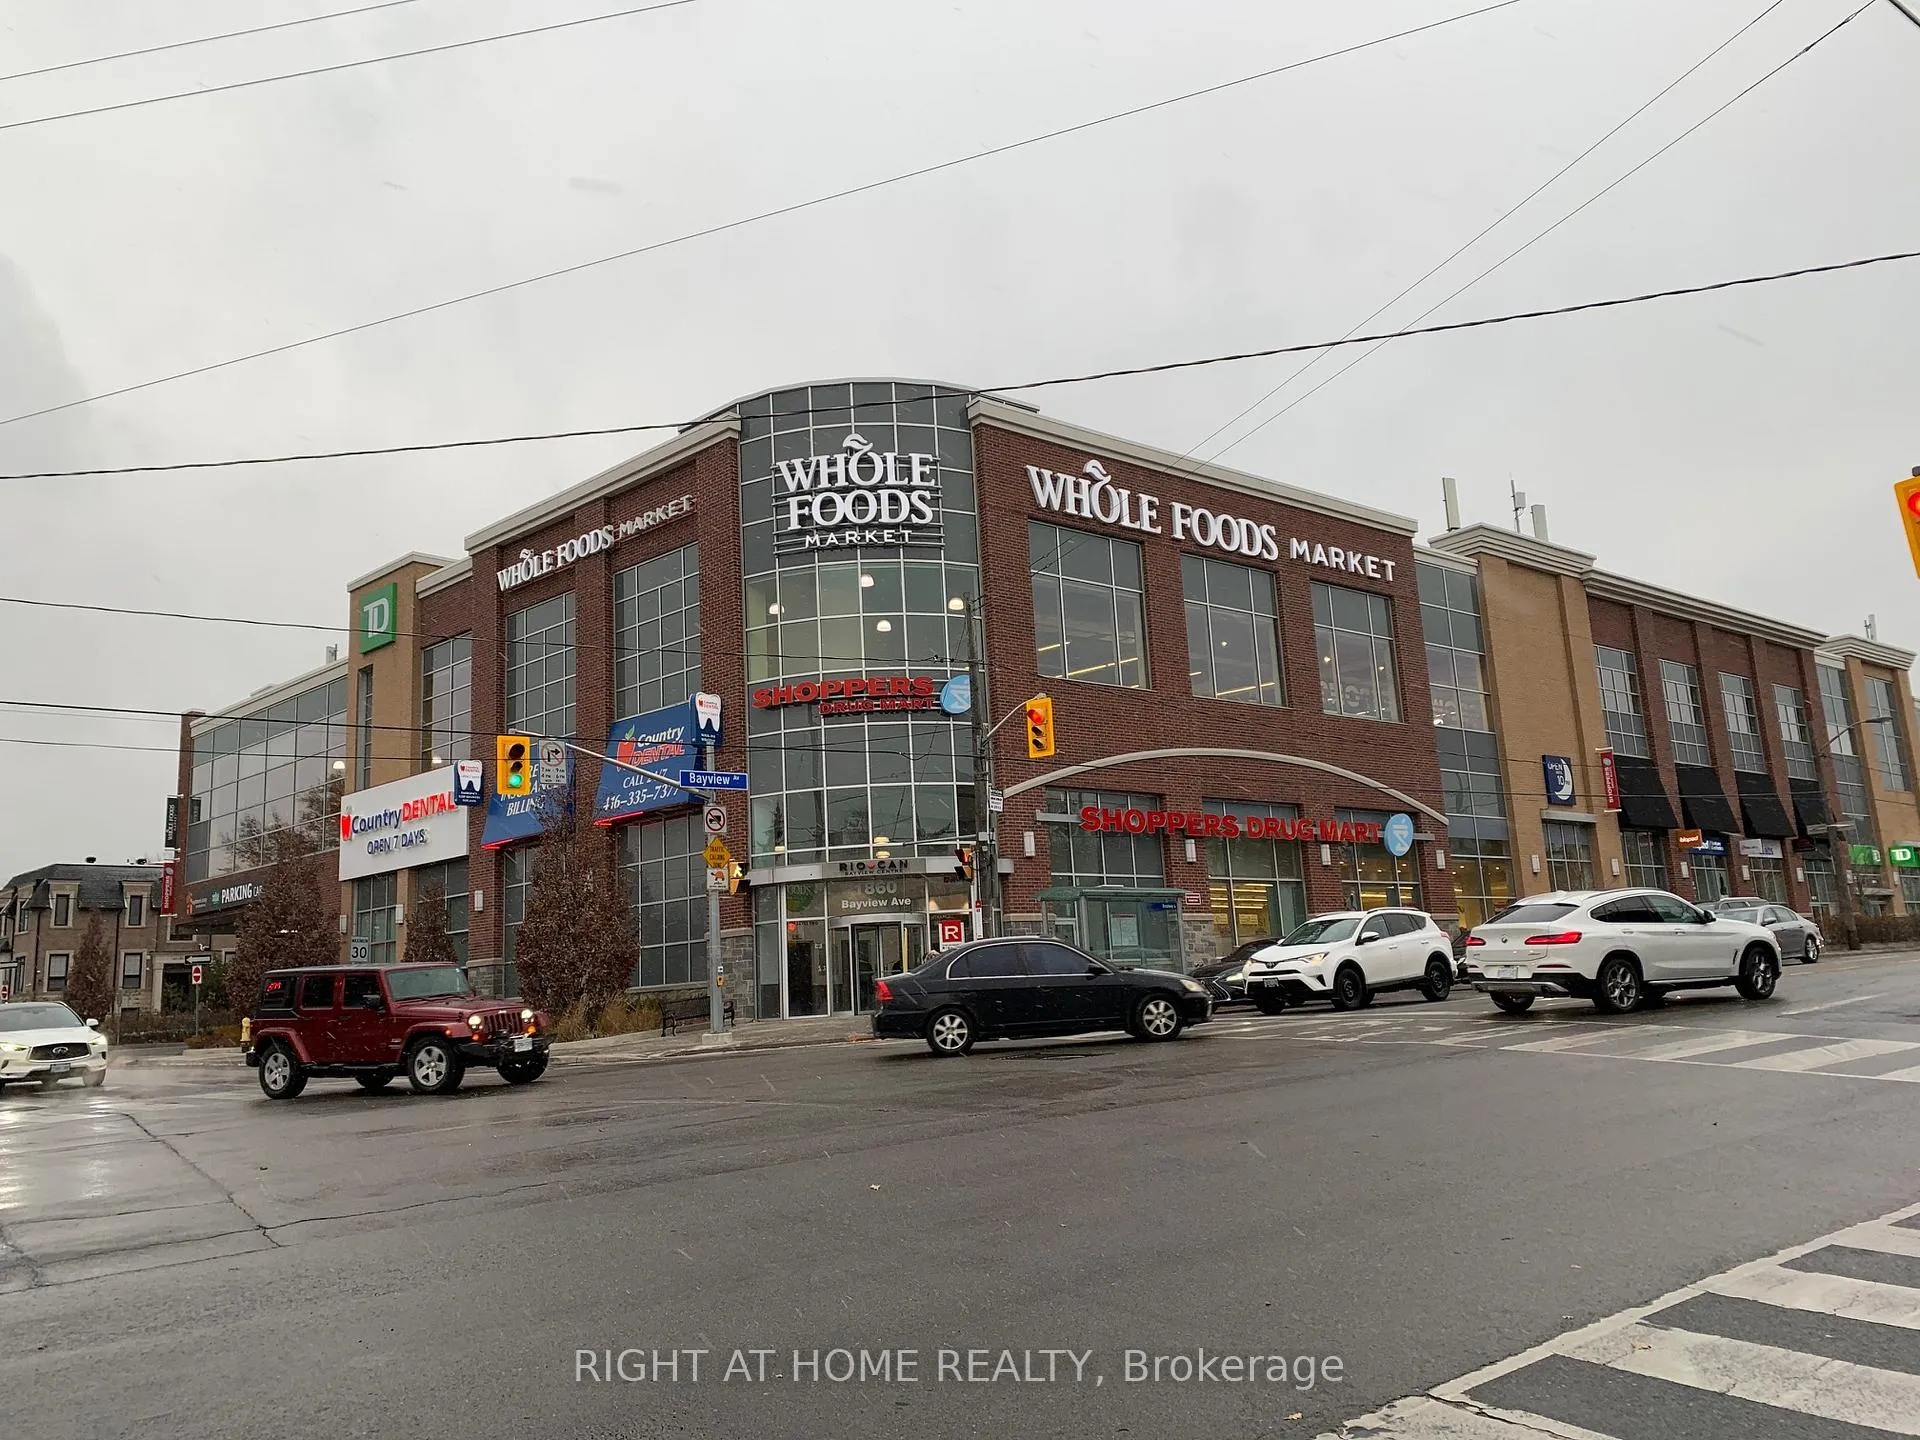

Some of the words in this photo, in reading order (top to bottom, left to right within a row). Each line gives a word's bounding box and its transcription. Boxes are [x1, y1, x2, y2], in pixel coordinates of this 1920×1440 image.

[776, 434, 935, 492] WHOLE
[786, 489, 934, 530] FOODS
[1026, 459, 1162, 535] WHOLE
[1170, 501, 1279, 561] FOODS
[1289, 537, 1396, 582] MARKET
[497, 548, 557, 592] WHOLE
[556, 525, 615, 568] FOODS
[619, 494, 694, 538] MARKET
[805, 530, 913, 548] MARKET
[363, 597, 389, 639] TD
[752, 676, 935, 709] SHOPPERS
[819, 700, 874, 715] DRUG
[880, 698, 935, 711] MART
[637, 726, 685, 747] Country
[632, 740, 685, 766] DENTAL
[623, 774, 644, 788] CALL
[646, 768, 668, 783] /7
[689, 772, 730, 787] Bayview
[351, 808, 402, 834] Country
[402, 791, 459, 822] DENTAL
[1080, 806, 1240, 839] SHOPPERS
[1247, 815, 1314, 842] DRUG
[1320, 818, 1383, 844] MART
[367, 838, 392, 855] OPEN
[393, 836, 399, 849] 7
[401, 828, 426, 847] DAYS
[1891, 848, 1911, 861] TD
[221, 883, 252, 904] PARKING
[841, 897, 888, 910] Bayview
[891, 897, 912, 906] Ave
[944, 926, 959, 940] R
[352, 946, 367, 958] 30
